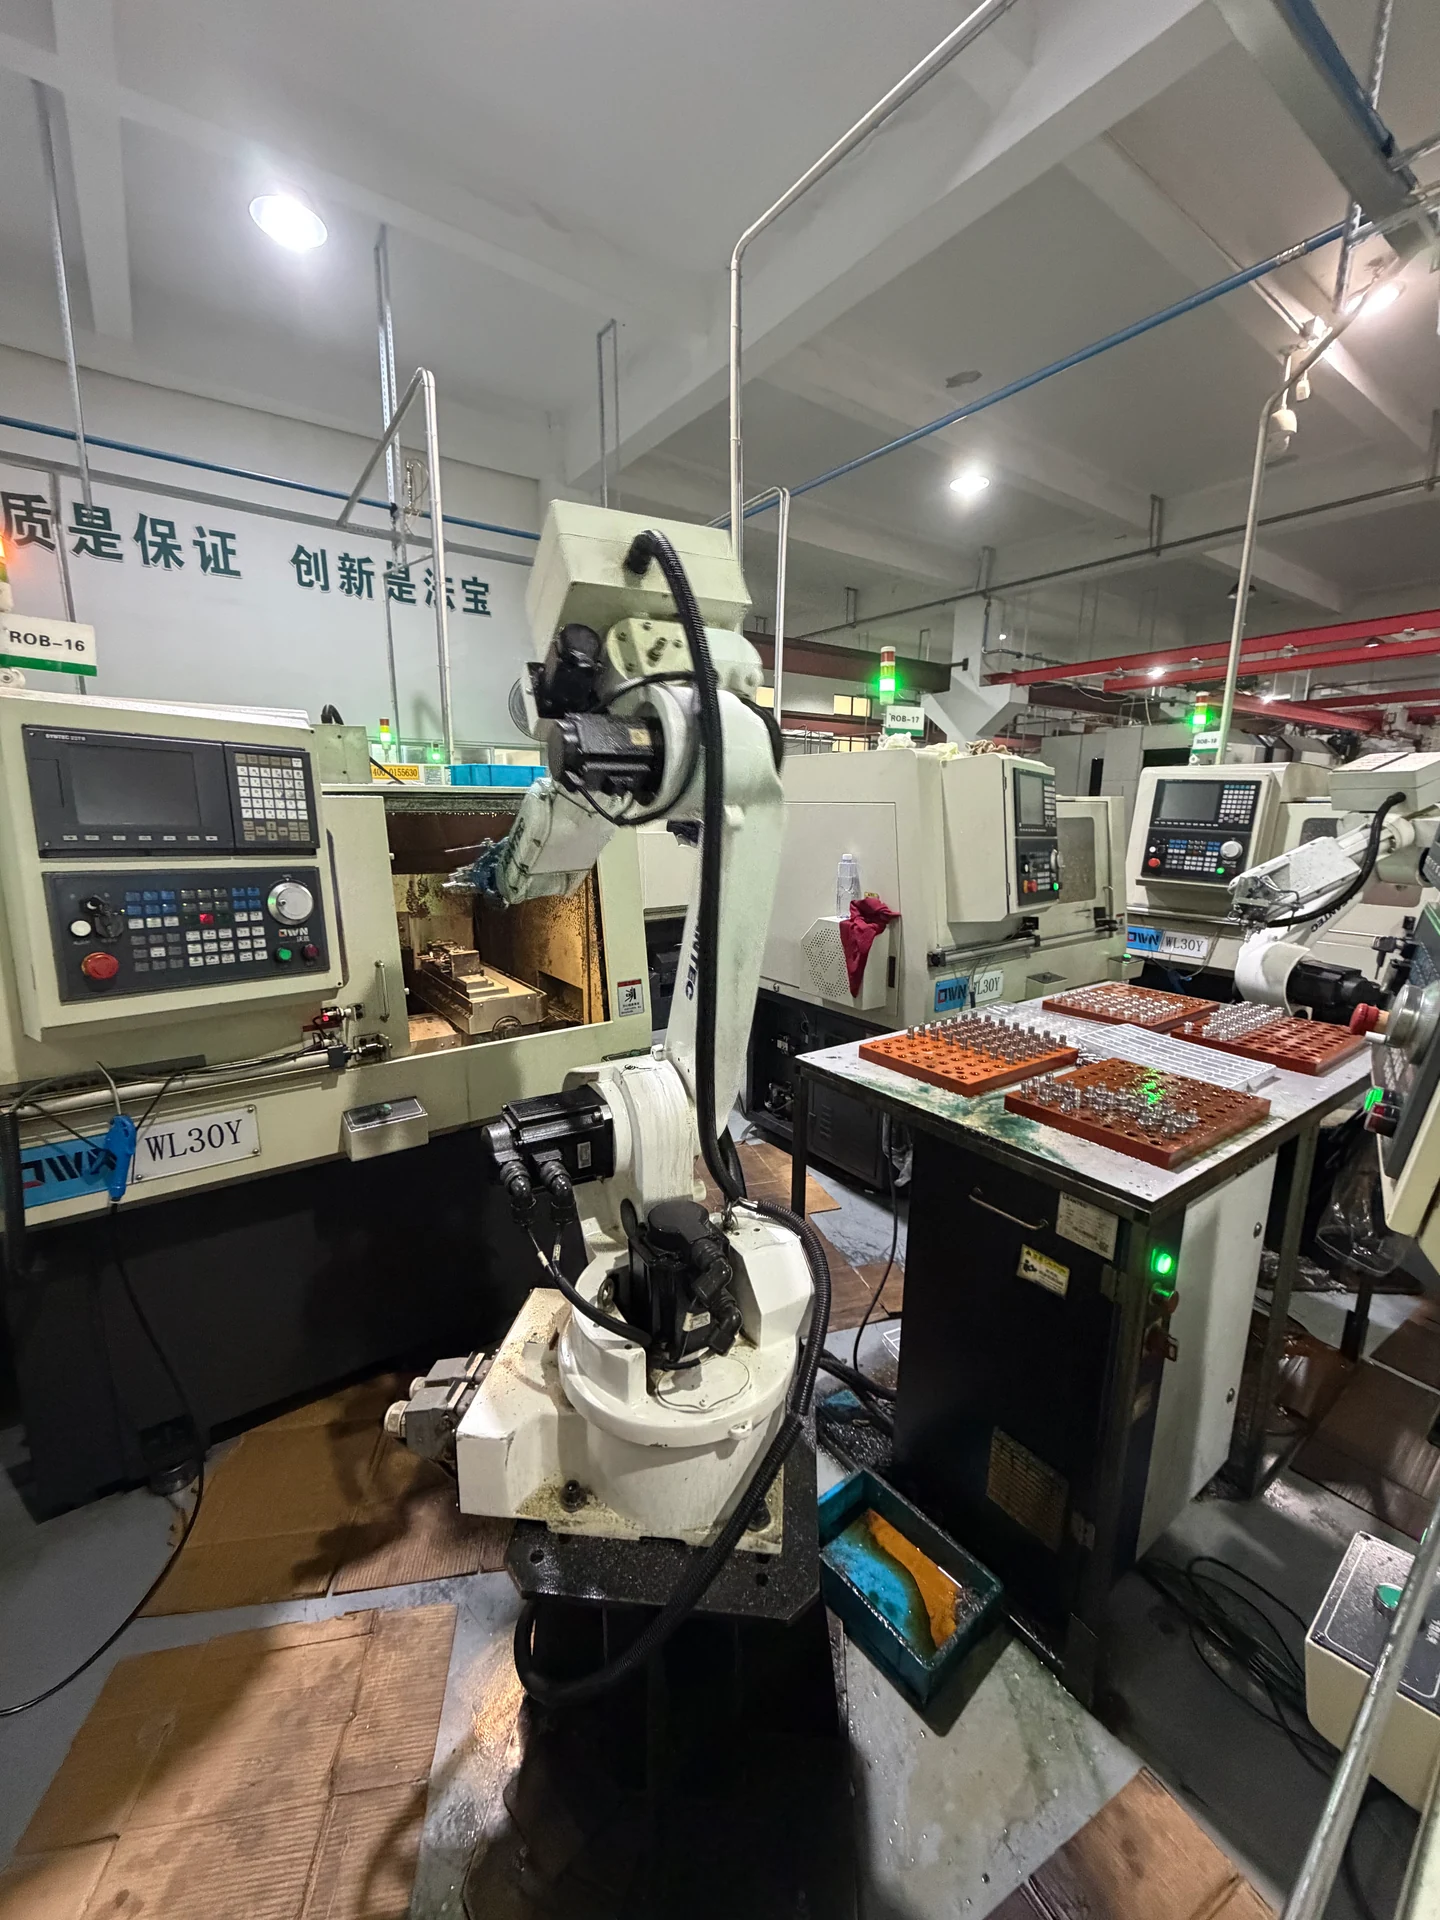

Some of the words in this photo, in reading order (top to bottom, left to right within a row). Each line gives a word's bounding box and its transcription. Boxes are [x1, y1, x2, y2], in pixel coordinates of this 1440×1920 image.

[0, 491, 242, 577] 质是保证
[290, 544, 492, 617] 创新是法宝
[9, 630, 86, 652] ROB-16
[890, 714, 920, 723] ROB-17
[372, 767, 418, 777] 4000155630
[1165, 936, 1204, 952] WL30Y
[145, 1118, 243, 1163] WL30Y
